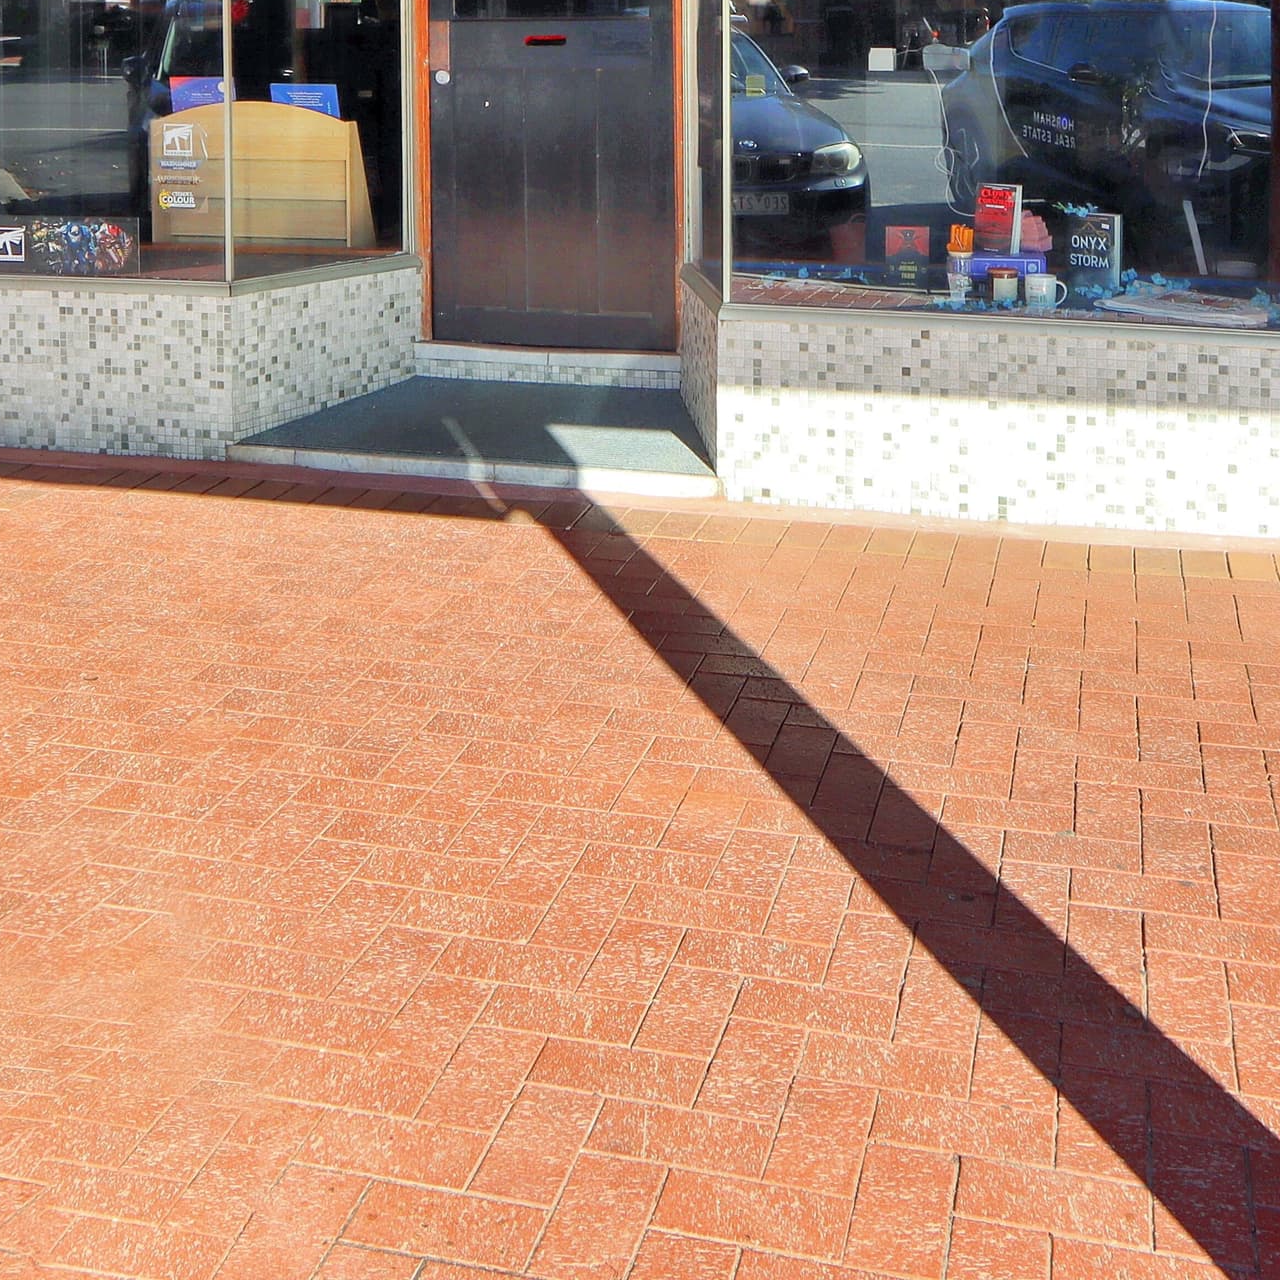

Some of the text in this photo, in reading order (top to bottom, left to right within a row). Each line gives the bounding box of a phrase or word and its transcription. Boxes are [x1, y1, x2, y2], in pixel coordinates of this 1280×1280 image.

[162, 196, 196, 204] COLOUR
[1071, 234, 1108, 252] ONYX
[1070, 253, 1110, 270] STORM
